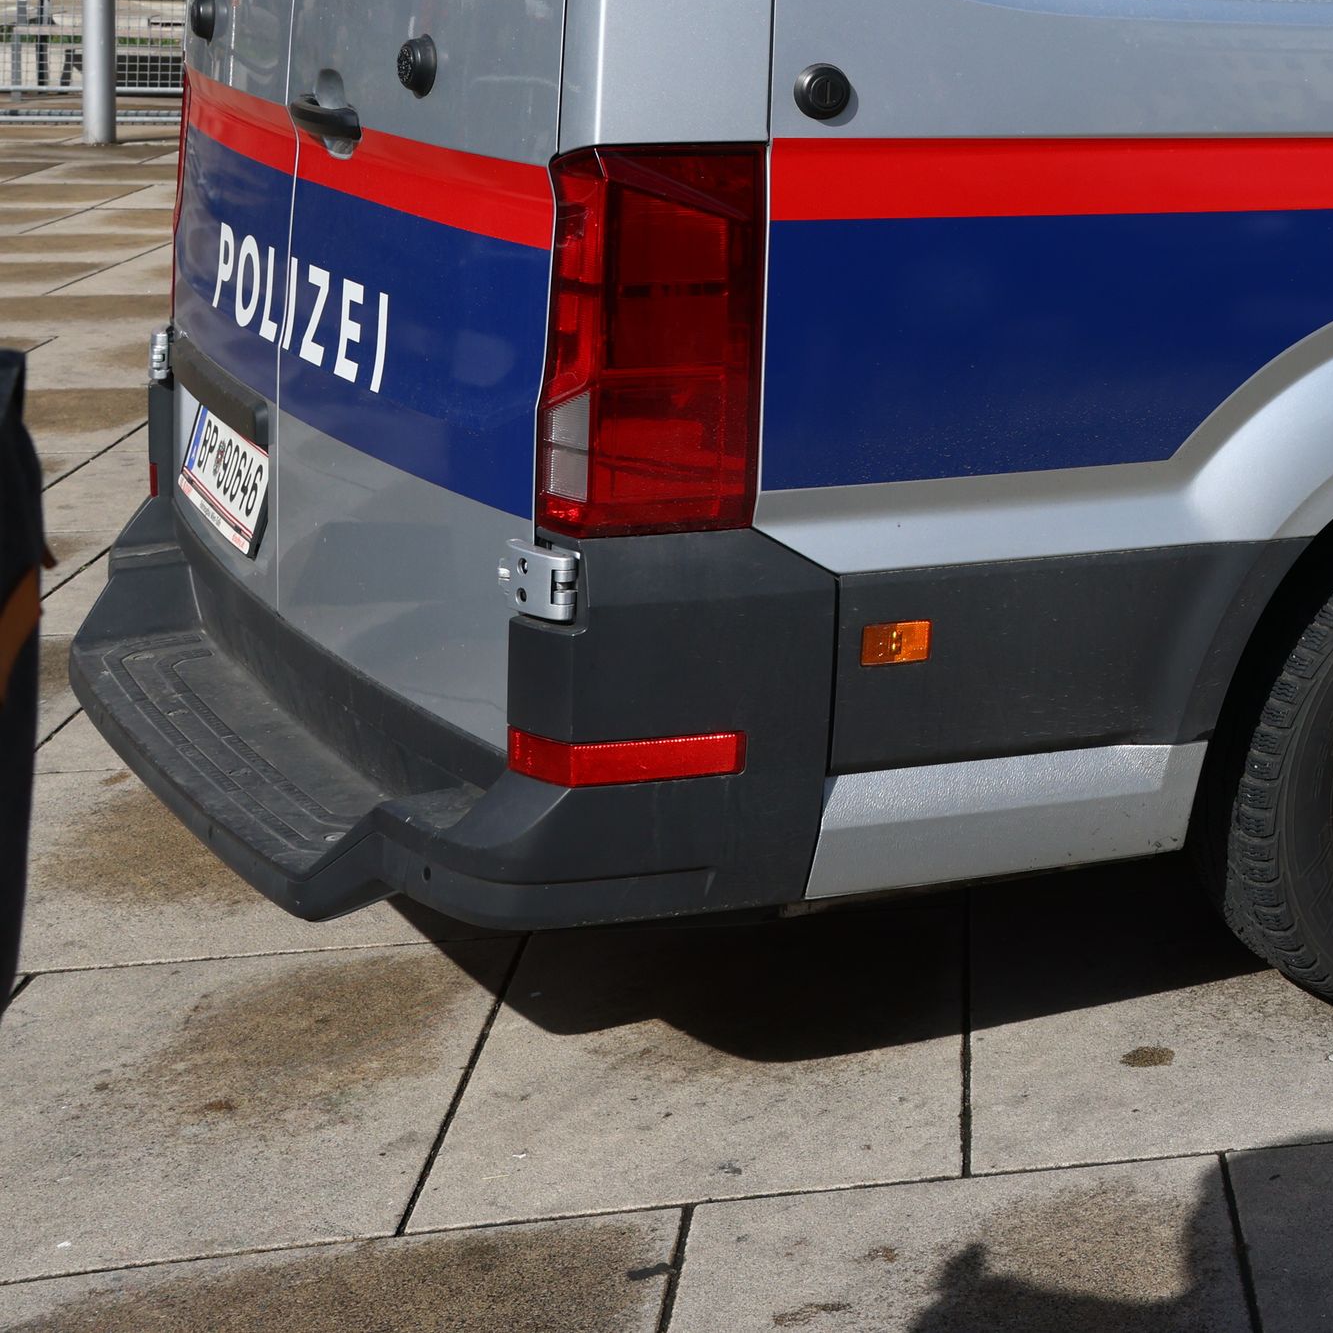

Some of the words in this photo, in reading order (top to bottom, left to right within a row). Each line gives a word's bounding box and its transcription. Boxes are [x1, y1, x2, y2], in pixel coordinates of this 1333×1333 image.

[212, 222, 389, 394] POLIZEI
[197, 419, 219, 473] BP
[216, 438, 263, 517] 90646
